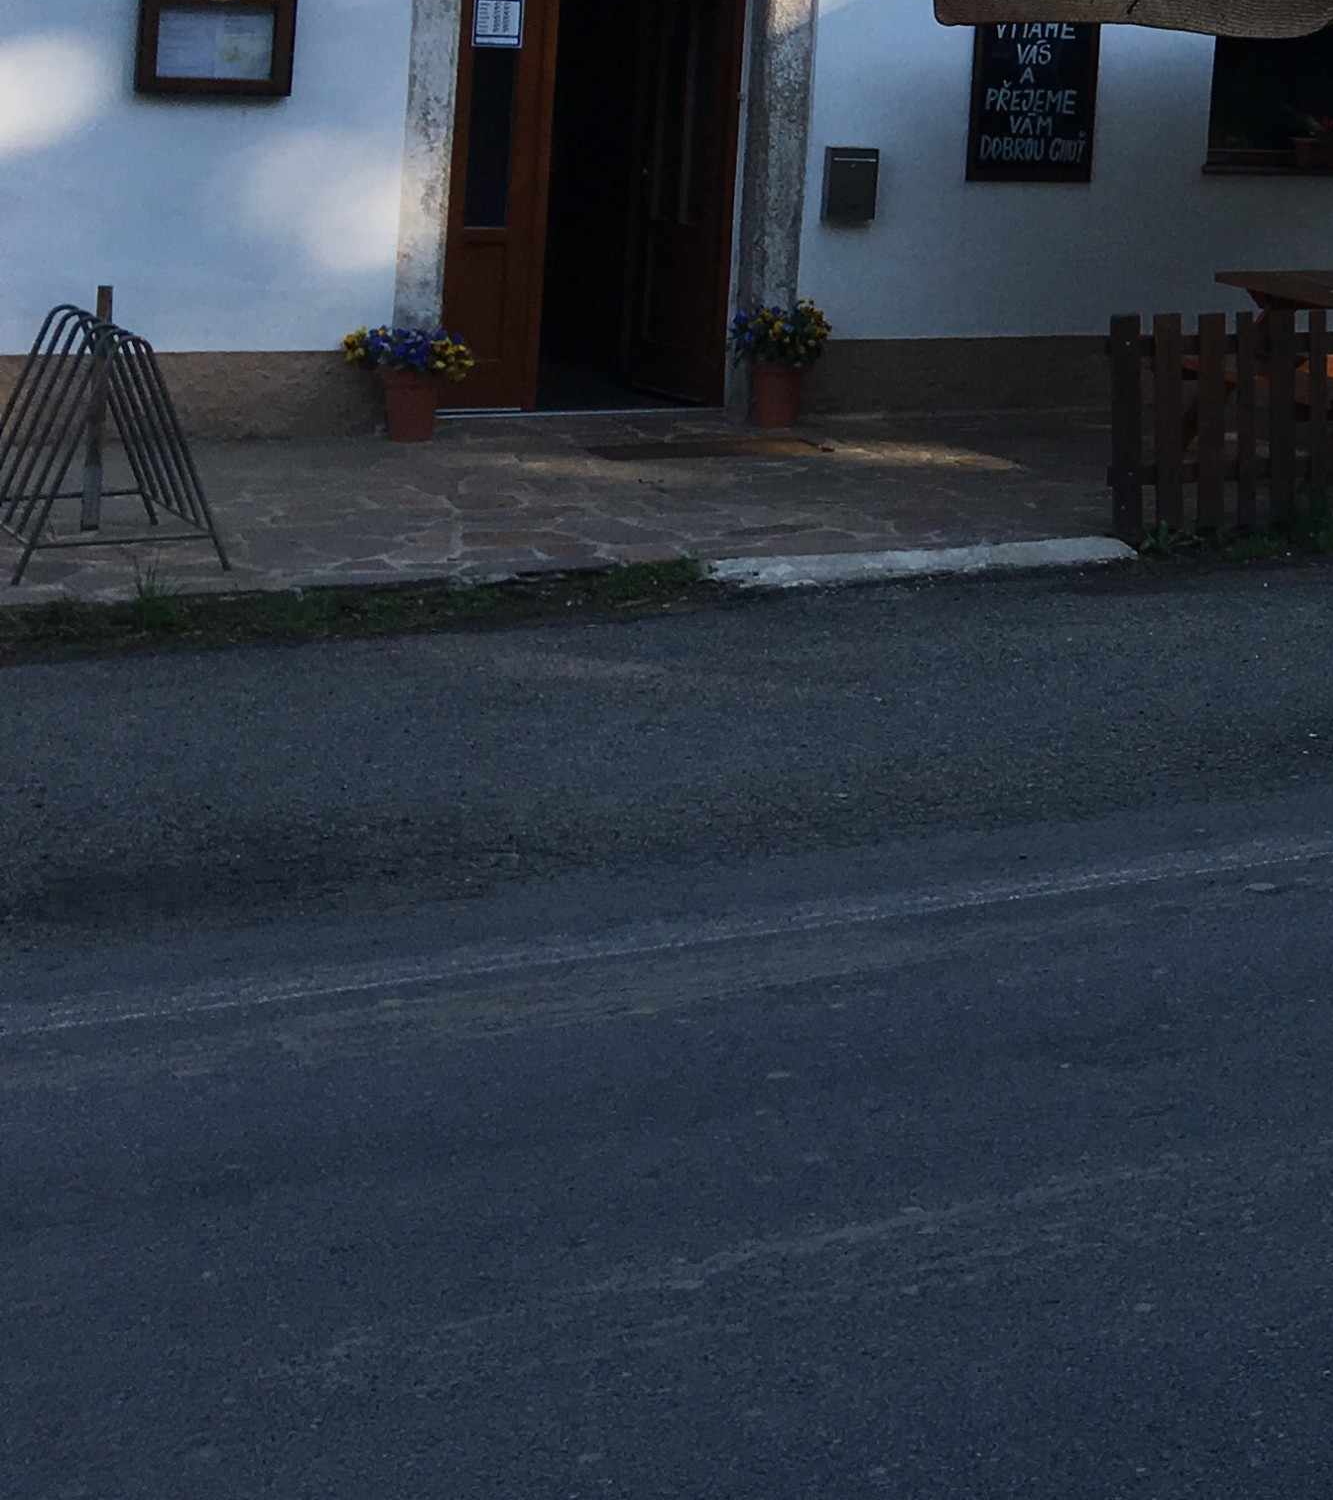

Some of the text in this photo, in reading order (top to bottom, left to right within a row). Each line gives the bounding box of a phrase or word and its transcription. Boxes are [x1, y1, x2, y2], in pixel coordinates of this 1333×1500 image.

[1019, 67, 1035, 84] A
[985, 80, 1078, 115] PŘEJEME
[980, 135, 1045, 162] DOBROU
